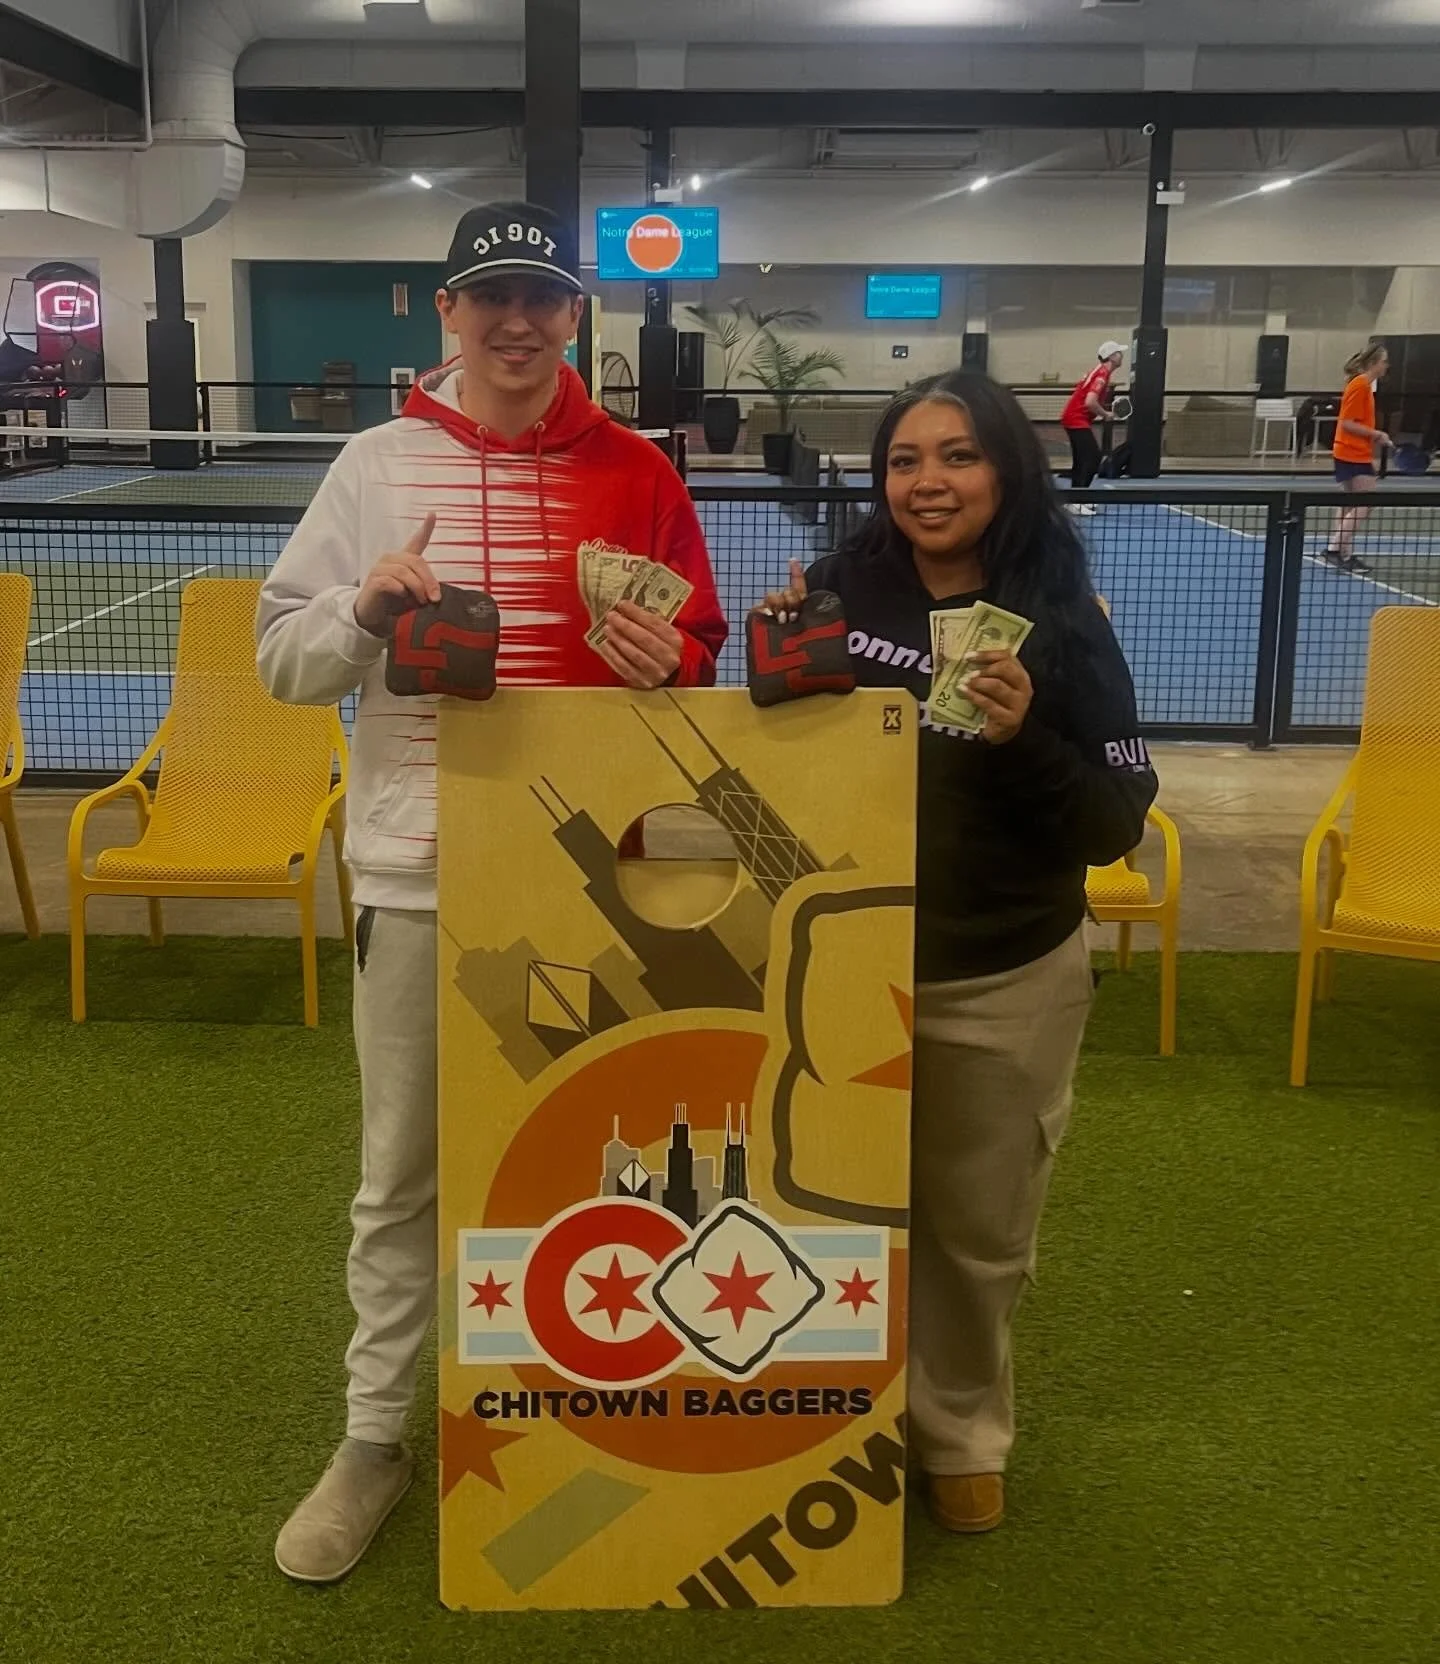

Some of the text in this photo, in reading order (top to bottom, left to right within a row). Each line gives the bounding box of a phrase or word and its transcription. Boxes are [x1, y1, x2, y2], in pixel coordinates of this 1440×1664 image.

[473, 223, 557, 257] LOGIC
[636, 226, 669, 238] Dame
[672, 225, 713, 239] League
[473, 1387, 873, 1419] CHITOWN BAGGERS
[649, 1413, 906, 1610] ITOW
